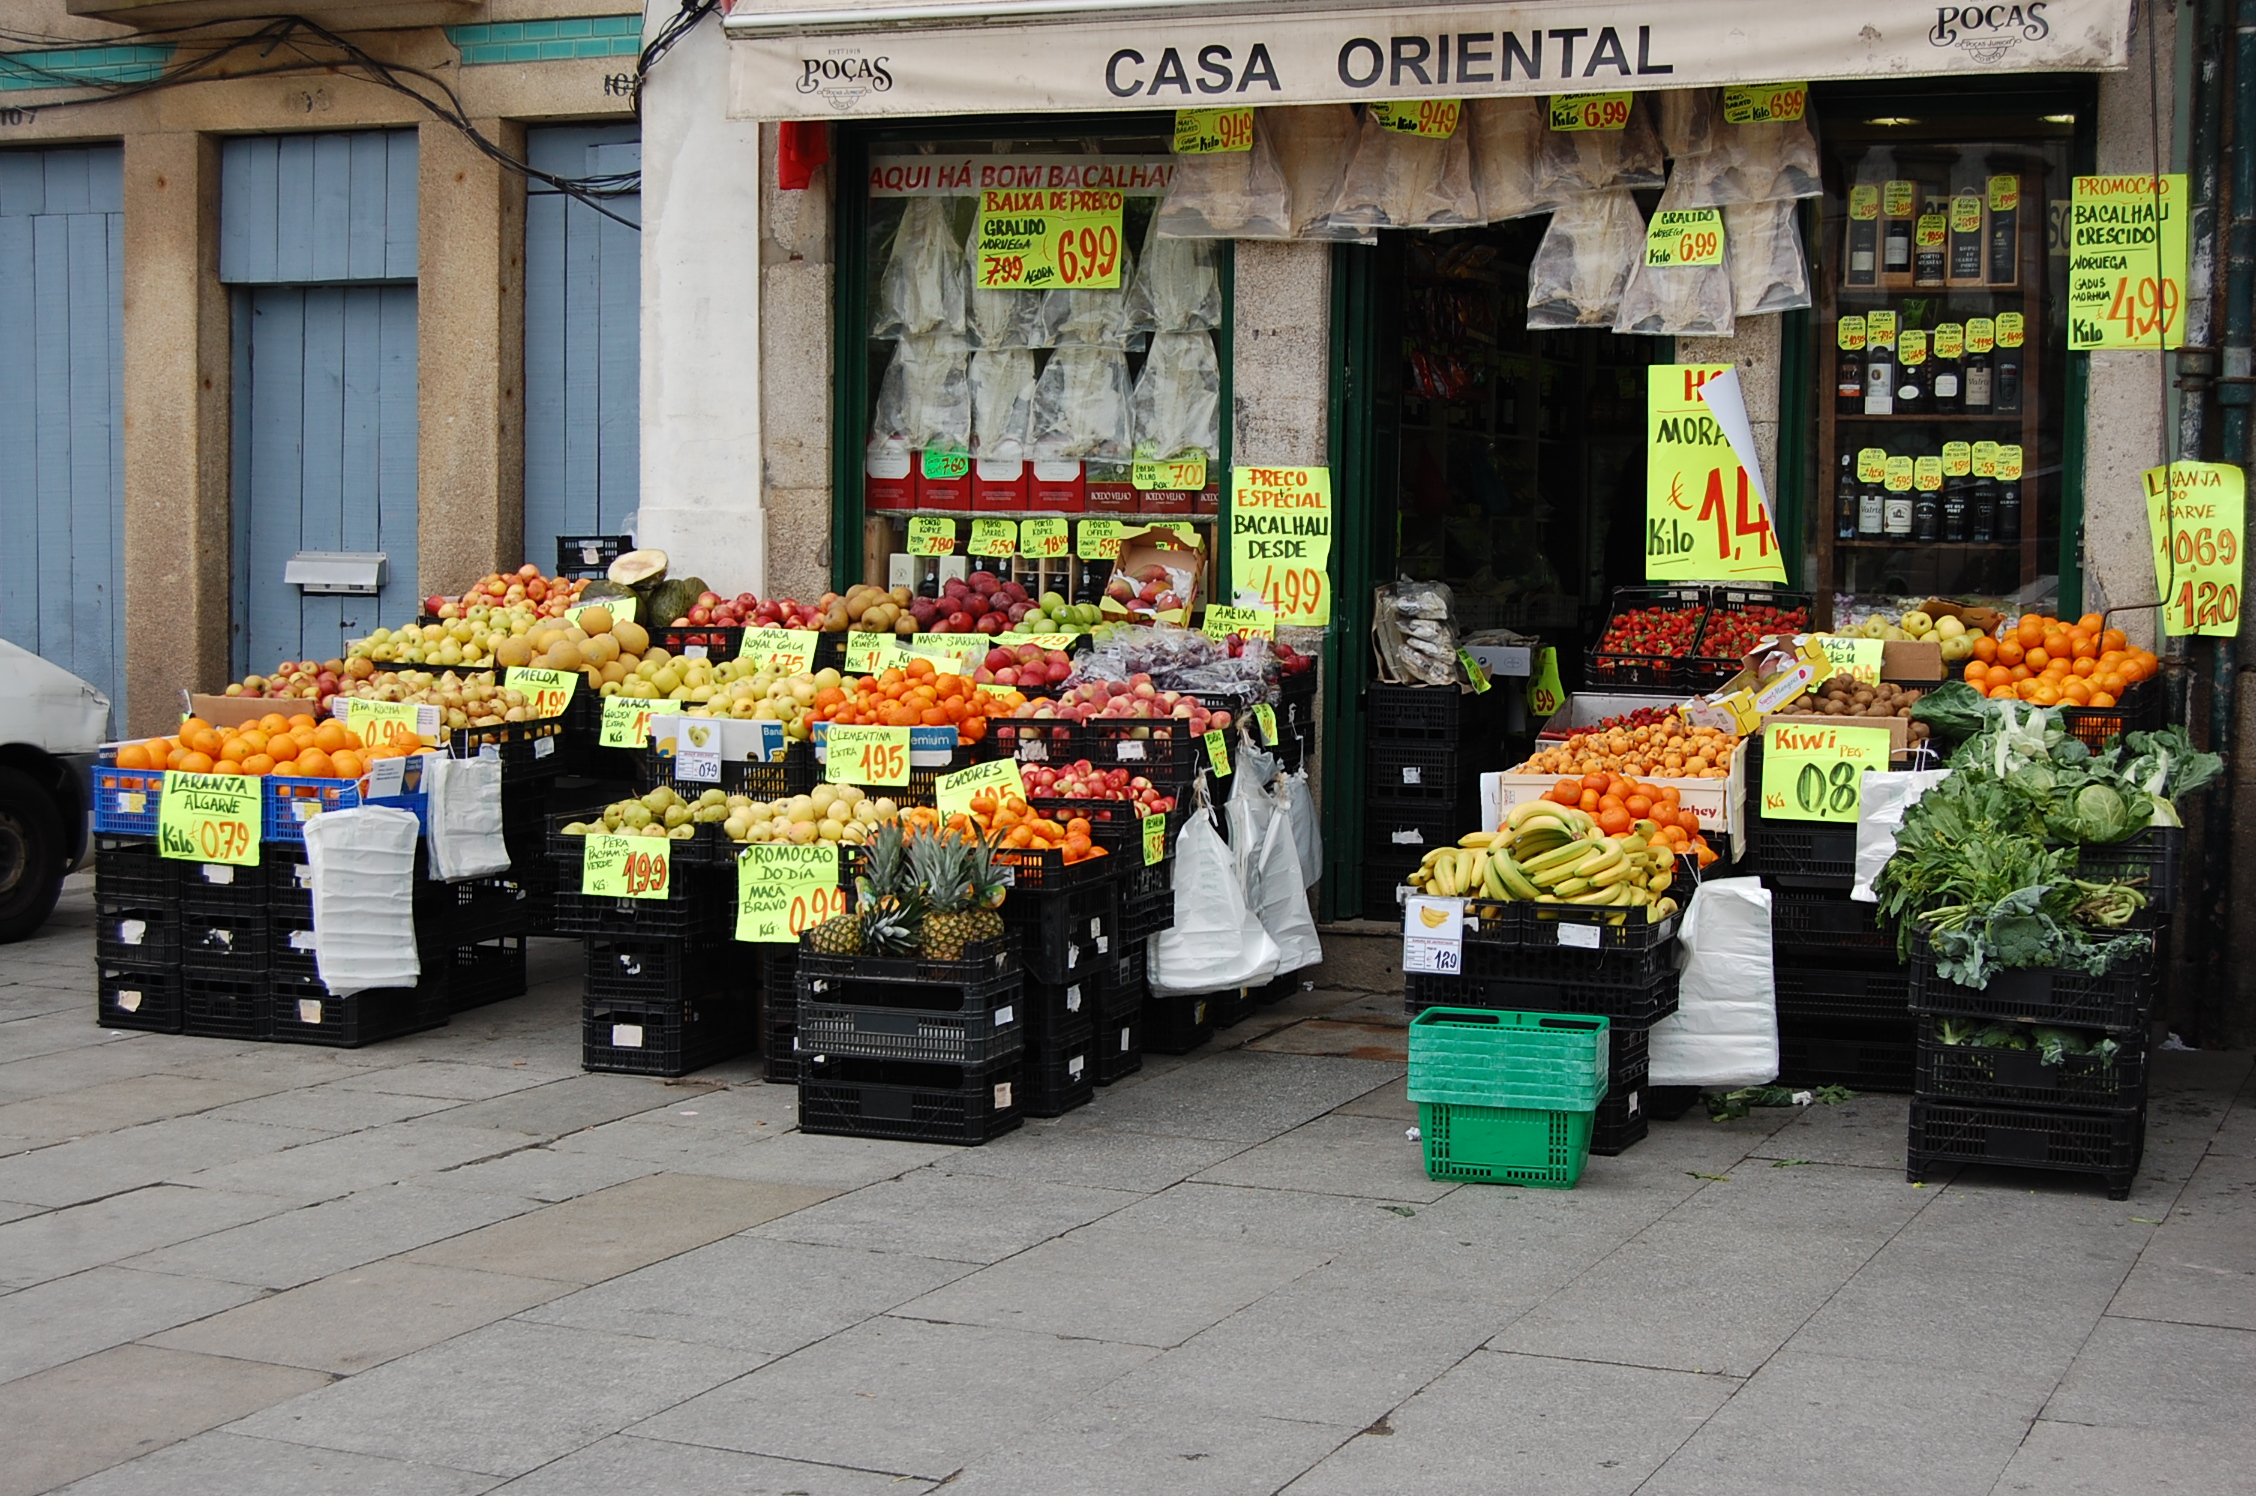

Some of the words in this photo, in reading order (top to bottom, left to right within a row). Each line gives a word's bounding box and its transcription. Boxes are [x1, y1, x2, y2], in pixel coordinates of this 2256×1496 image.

[1929, 2, 2049, 47] POÇAS
[1105, 43, 1282, 97] CASA
[1338, 25, 1674, 88] ORIENTAL
[796, 56, 893, 94] POÇAS
[869, 166, 931, 191] AQUI
[937, 160, 973, 188] HÁ
[981, 165, 1043, 188] BOM
[1046, 164, 1175, 188] BACALHA
[984, 191, 1045, 212] BAIXA
[1050, 191, 1068, 211] DE
[979, 239, 1032, 250] NORUEGA
[2076, 227, 2156, 246] CRESCIDO
[1648, 249, 1671, 264] Kilo
[2070, 254, 2128, 271] NORUEGA
[2074, 277, 2106, 290] GADUS
[2073, 318, 2104, 343] Kilo
[1684, 369, 1723, 402] H
[1237, 488, 1327, 509] ESPECIAL
[1032, 528, 1053, 536] KOPKE
[1233, 514, 1329, 537] BACALHAU
[1648, 518, 1694, 555] Kilo
[1248, 540, 1307, 559] DESDE
[1215, 606, 1257, 621] AMEIXA
[744, 637, 771, 650] ROYAL
[513, 670, 561, 686] MELOA
[373, 702, 400, 715] ROCHA
[604, 710, 631, 719] GOLDEN
[606, 720, 626, 728] EXTRA
[829, 727, 892, 741] CLEMENTINA
[910, 735, 950, 746] emium
[830, 746, 857, 759] EXTRA
[828, 767, 841, 778] KG
[945, 762, 1003, 790] ENCORES
[171, 773, 248, 795] LARANJA
[184, 793, 242, 814] ALGARVE
[1766, 792, 1785, 809] KG
[162, 822, 195, 853] Kilo
[586, 859, 613, 871] VERDE
[757, 866, 783, 880] DO
[741, 899, 787, 914] BRAVO
